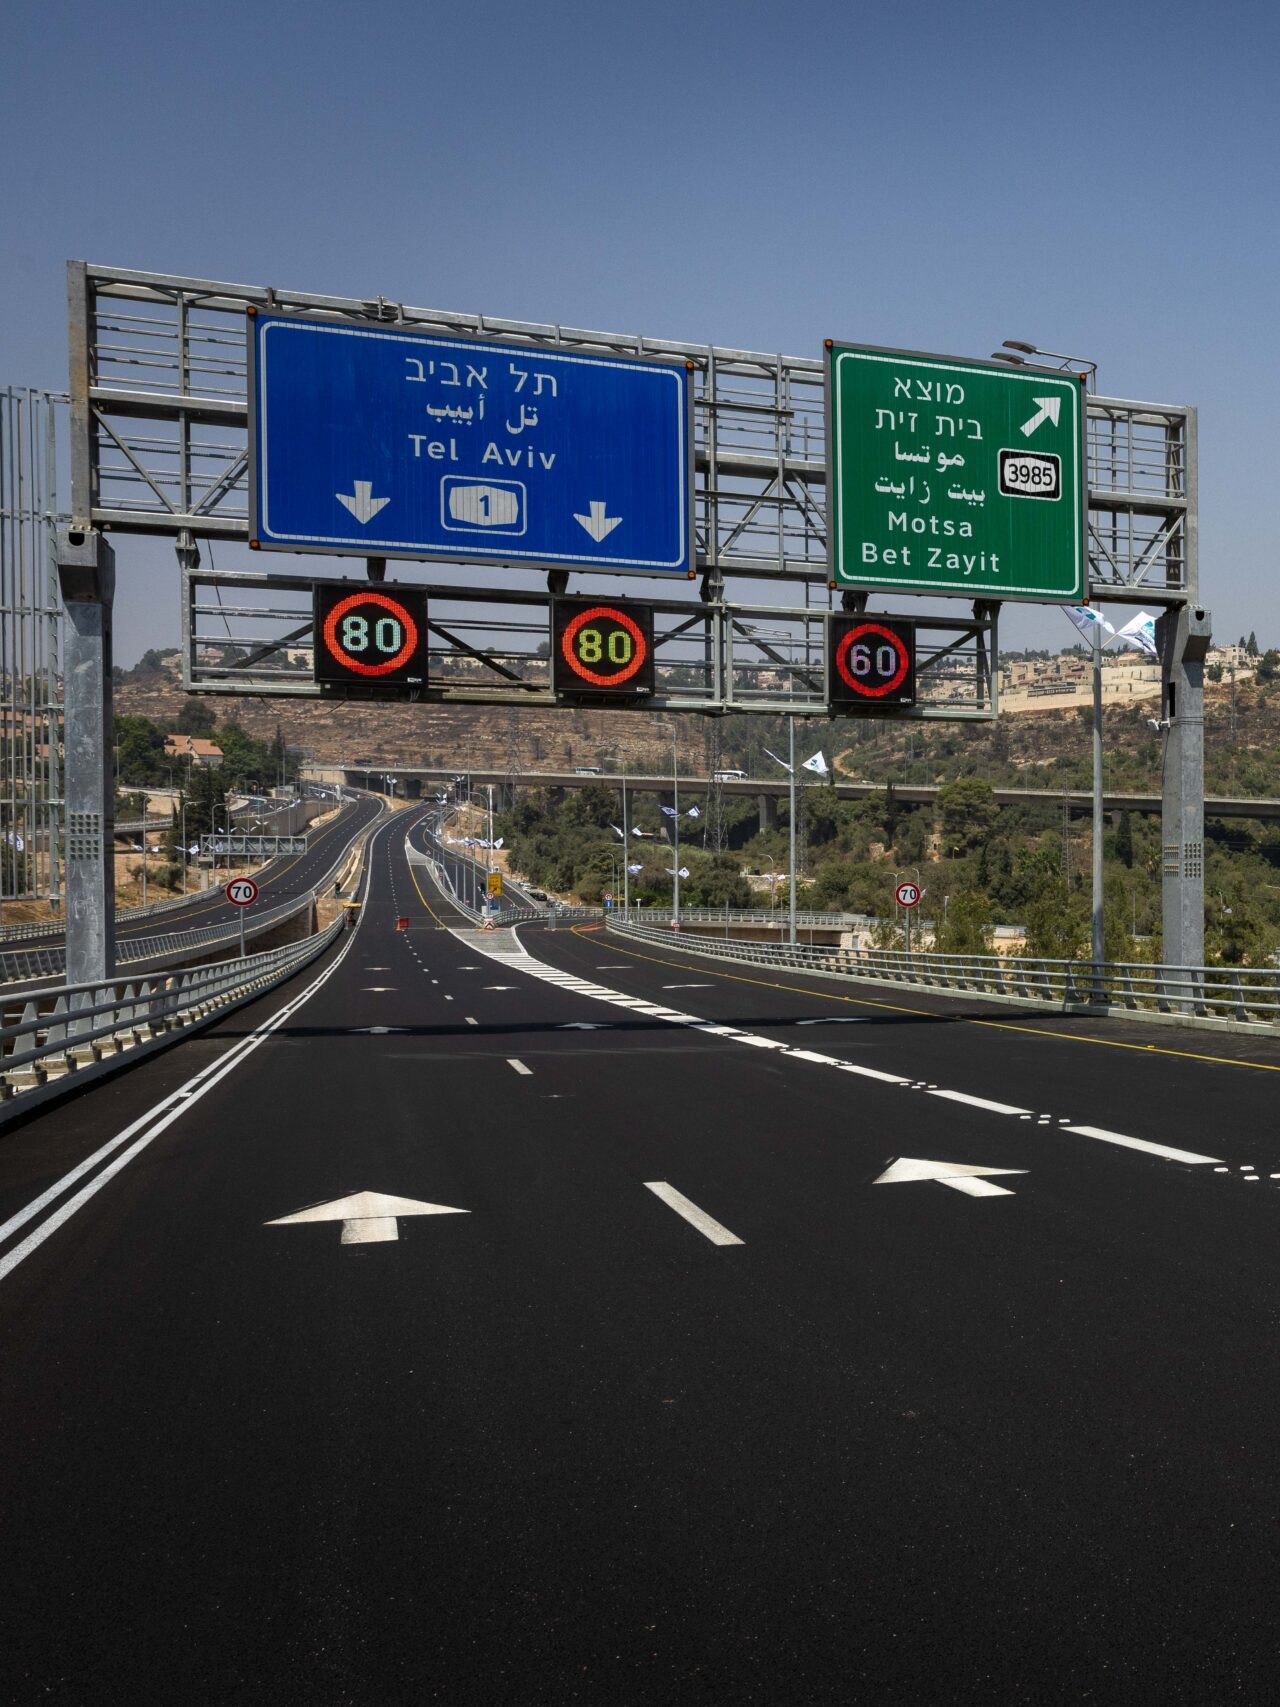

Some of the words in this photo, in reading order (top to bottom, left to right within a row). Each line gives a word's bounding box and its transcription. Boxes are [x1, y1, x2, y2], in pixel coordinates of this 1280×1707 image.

[405, 357, 489, 389] אביב
[509, 363, 558, 397] תל
[894, 377, 965, 405] מוצא
[426, 393, 486, 426] أبيب
[505, 404, 539, 434] تل
[875, 408, 919, 433] זית
[935, 415, 984, 440] בית
[408, 434, 459, 461] Tel
[481, 442, 556, 470] Aviv
[894, 441, 966, 472] موتسا
[1008, 463, 1053, 486] 3985
[874, 476, 931, 505] زايت
[947, 483, 986, 507] بيت
[479, 494, 490, 517] 1
[888, 510, 973, 538] Motsa
[861, 542, 911, 566] Bet
[927, 547, 1000, 575] Zayit
[342, 616, 401, 653] 80
[579, 629, 631, 664] 80
[850, 644, 896, 677] 60
[232, 886, 253, 899] 70
[900, 889, 917, 901] 70
